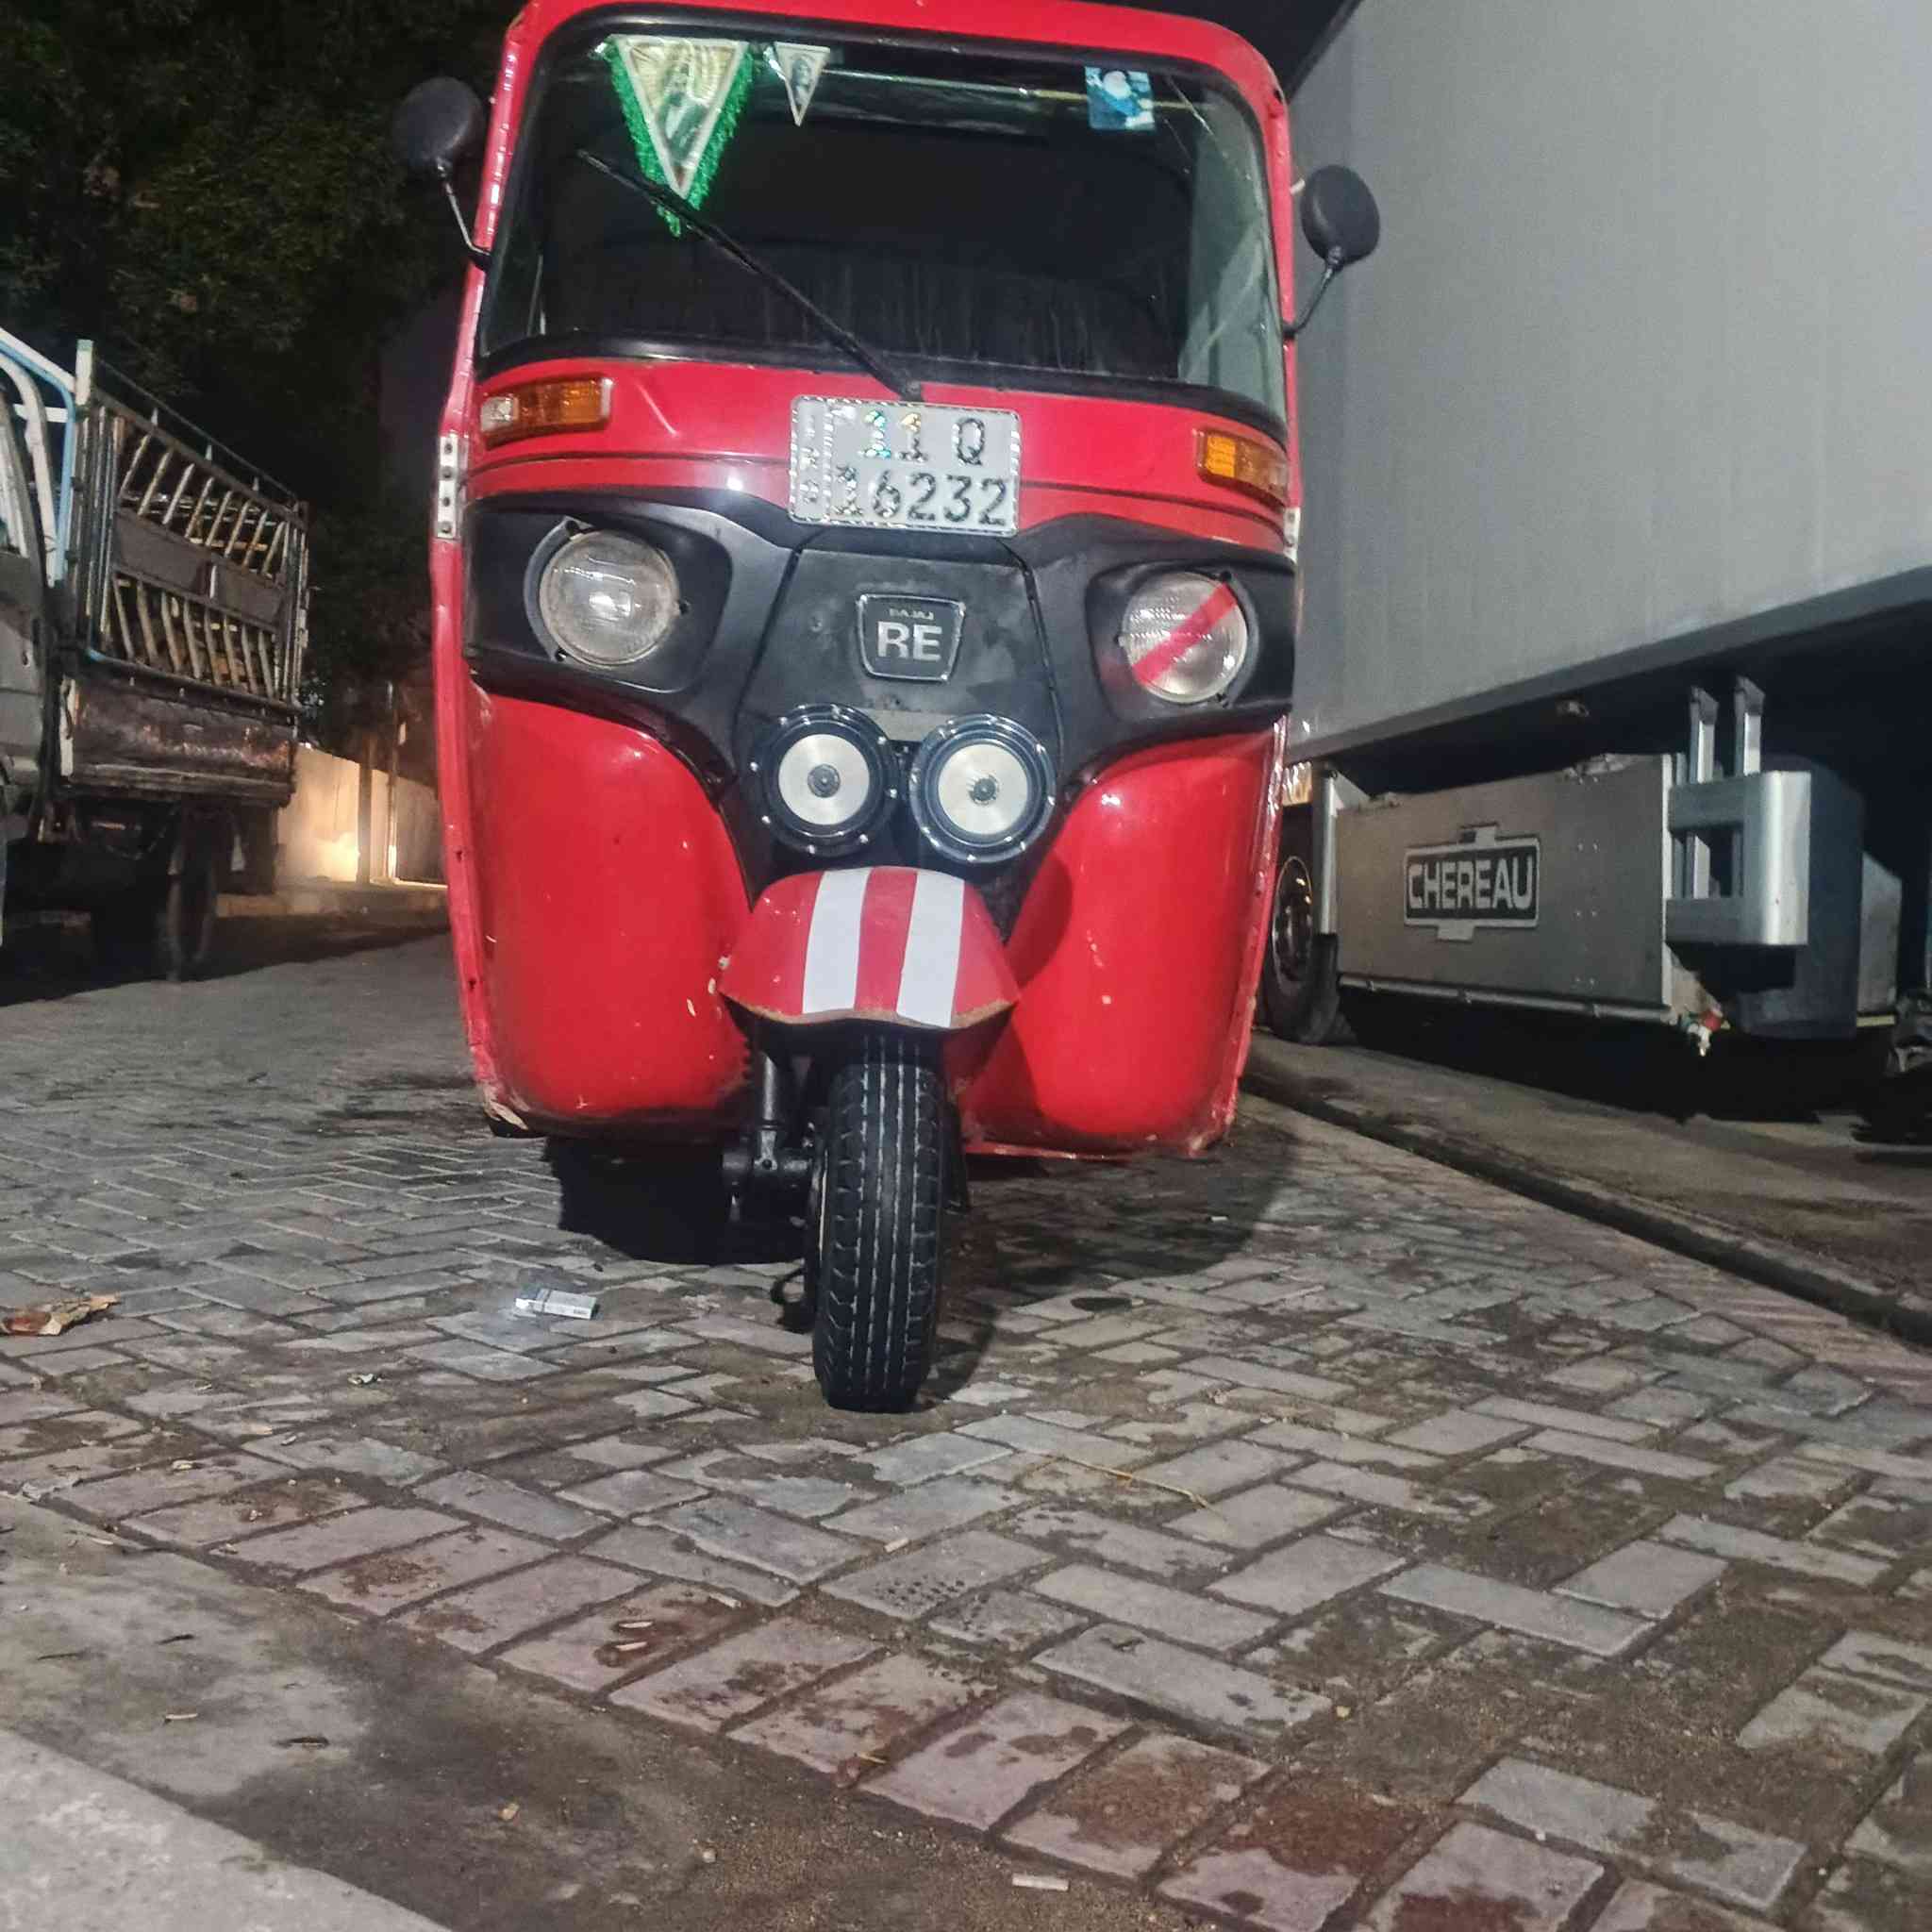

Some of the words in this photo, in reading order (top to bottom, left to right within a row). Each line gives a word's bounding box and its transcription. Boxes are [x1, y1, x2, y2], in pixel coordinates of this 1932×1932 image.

[952, 417, 983, 466] Q
[877, 620, 942, 661] RE
[1407, 855, 1534, 910] CHEREAU
